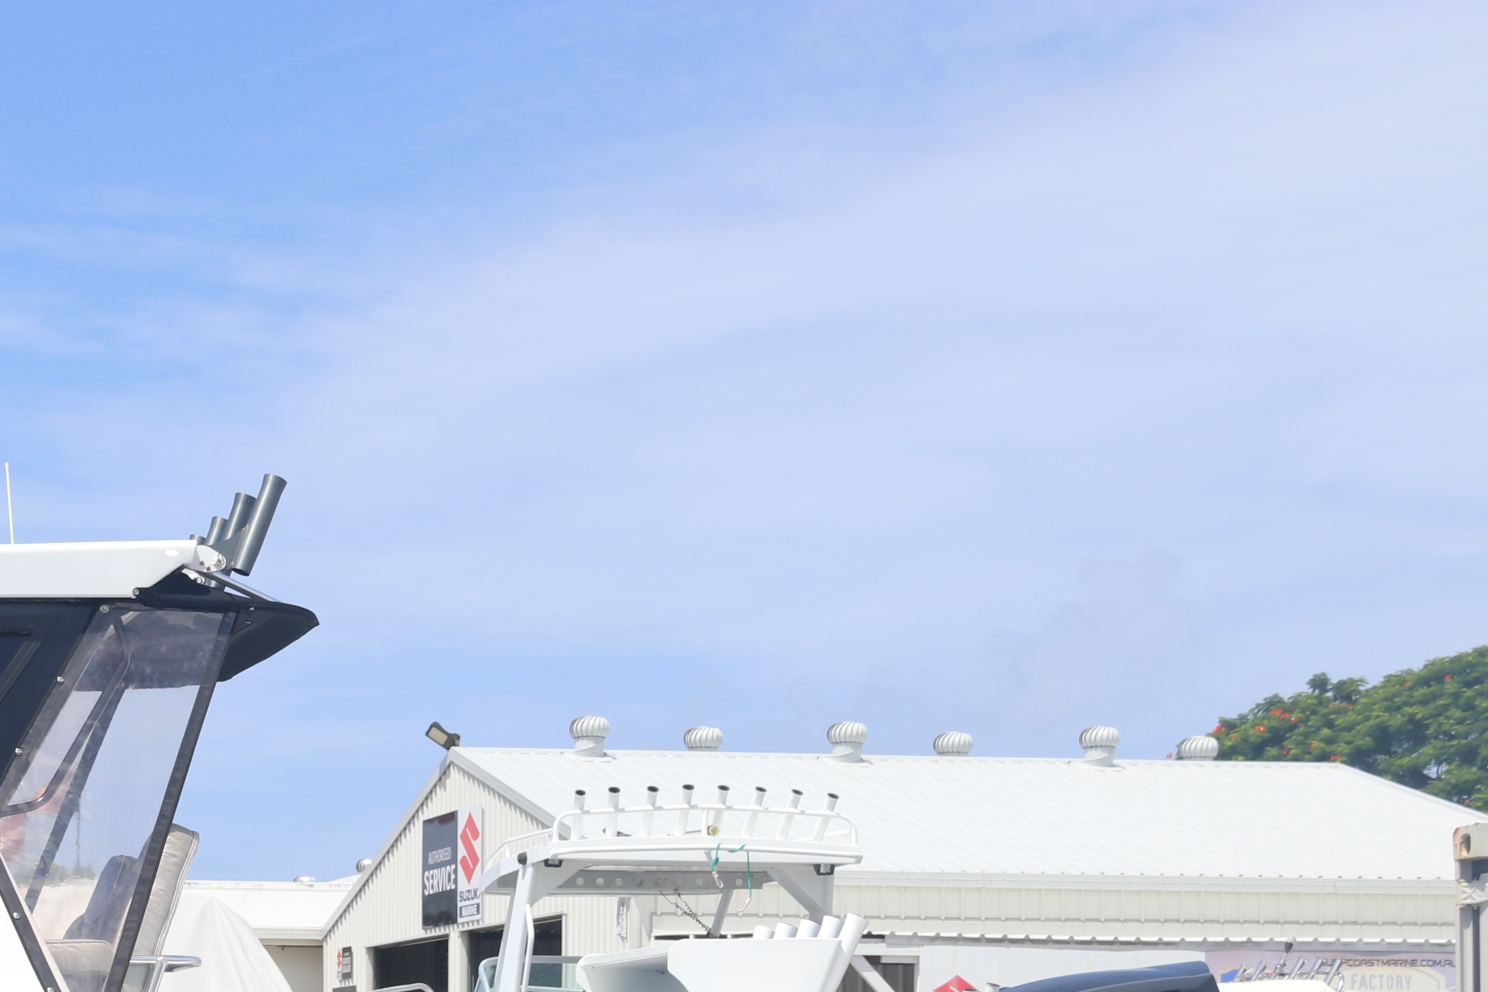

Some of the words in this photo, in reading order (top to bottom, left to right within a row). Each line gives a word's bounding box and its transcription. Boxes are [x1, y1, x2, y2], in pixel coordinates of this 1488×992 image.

[424, 864, 455, 896] SERVICE
[461, 904, 478, 917] MARINE
[1350, 974, 1412, 991] FACTORY
